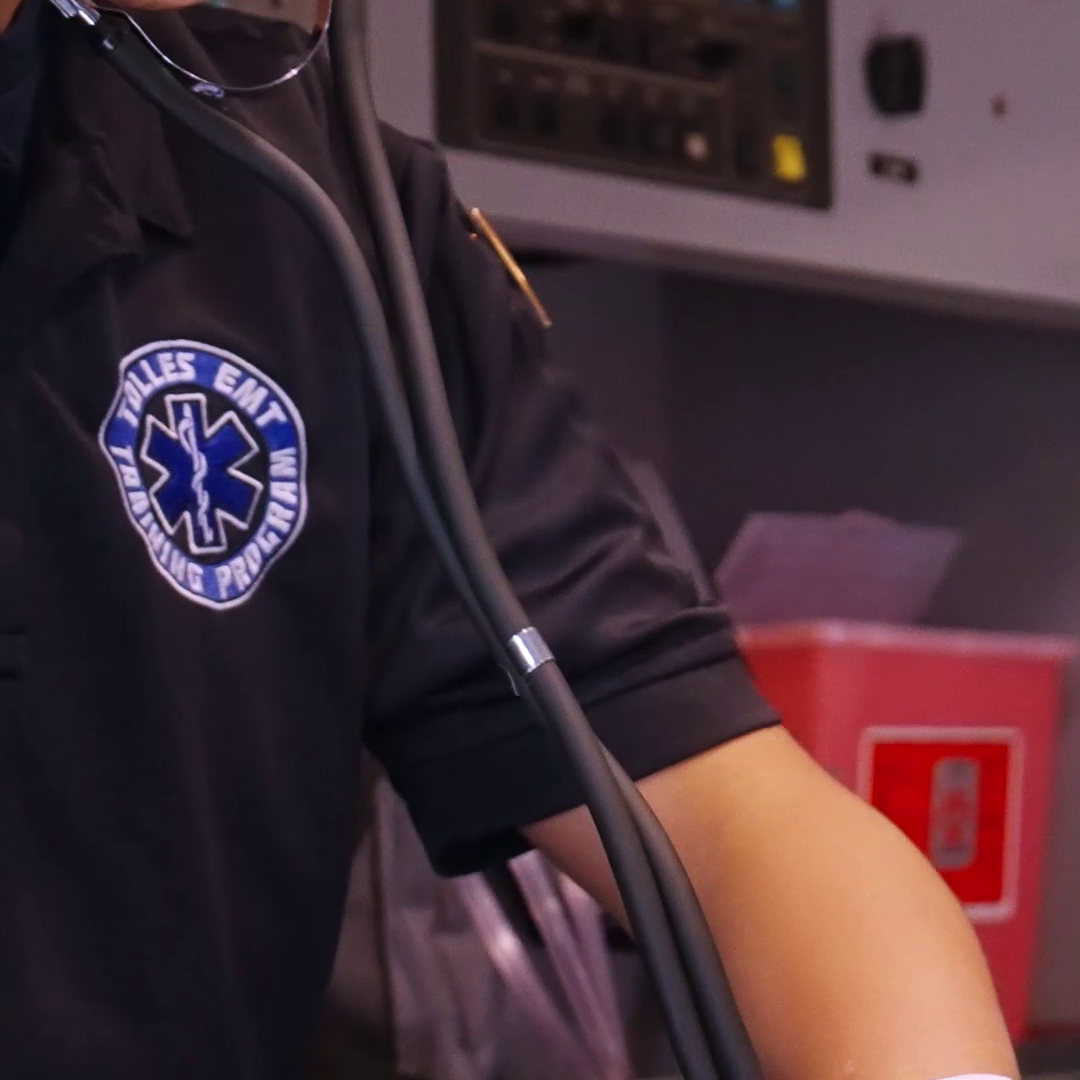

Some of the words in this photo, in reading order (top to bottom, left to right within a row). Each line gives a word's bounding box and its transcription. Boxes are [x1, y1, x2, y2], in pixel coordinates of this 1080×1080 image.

[117, 351, 195, 428] TOLLES
[213, 361, 288, 427] EMT
[108, 444, 205, 593] TRAINING
[214, 447, 298, 599] PROGRAM
